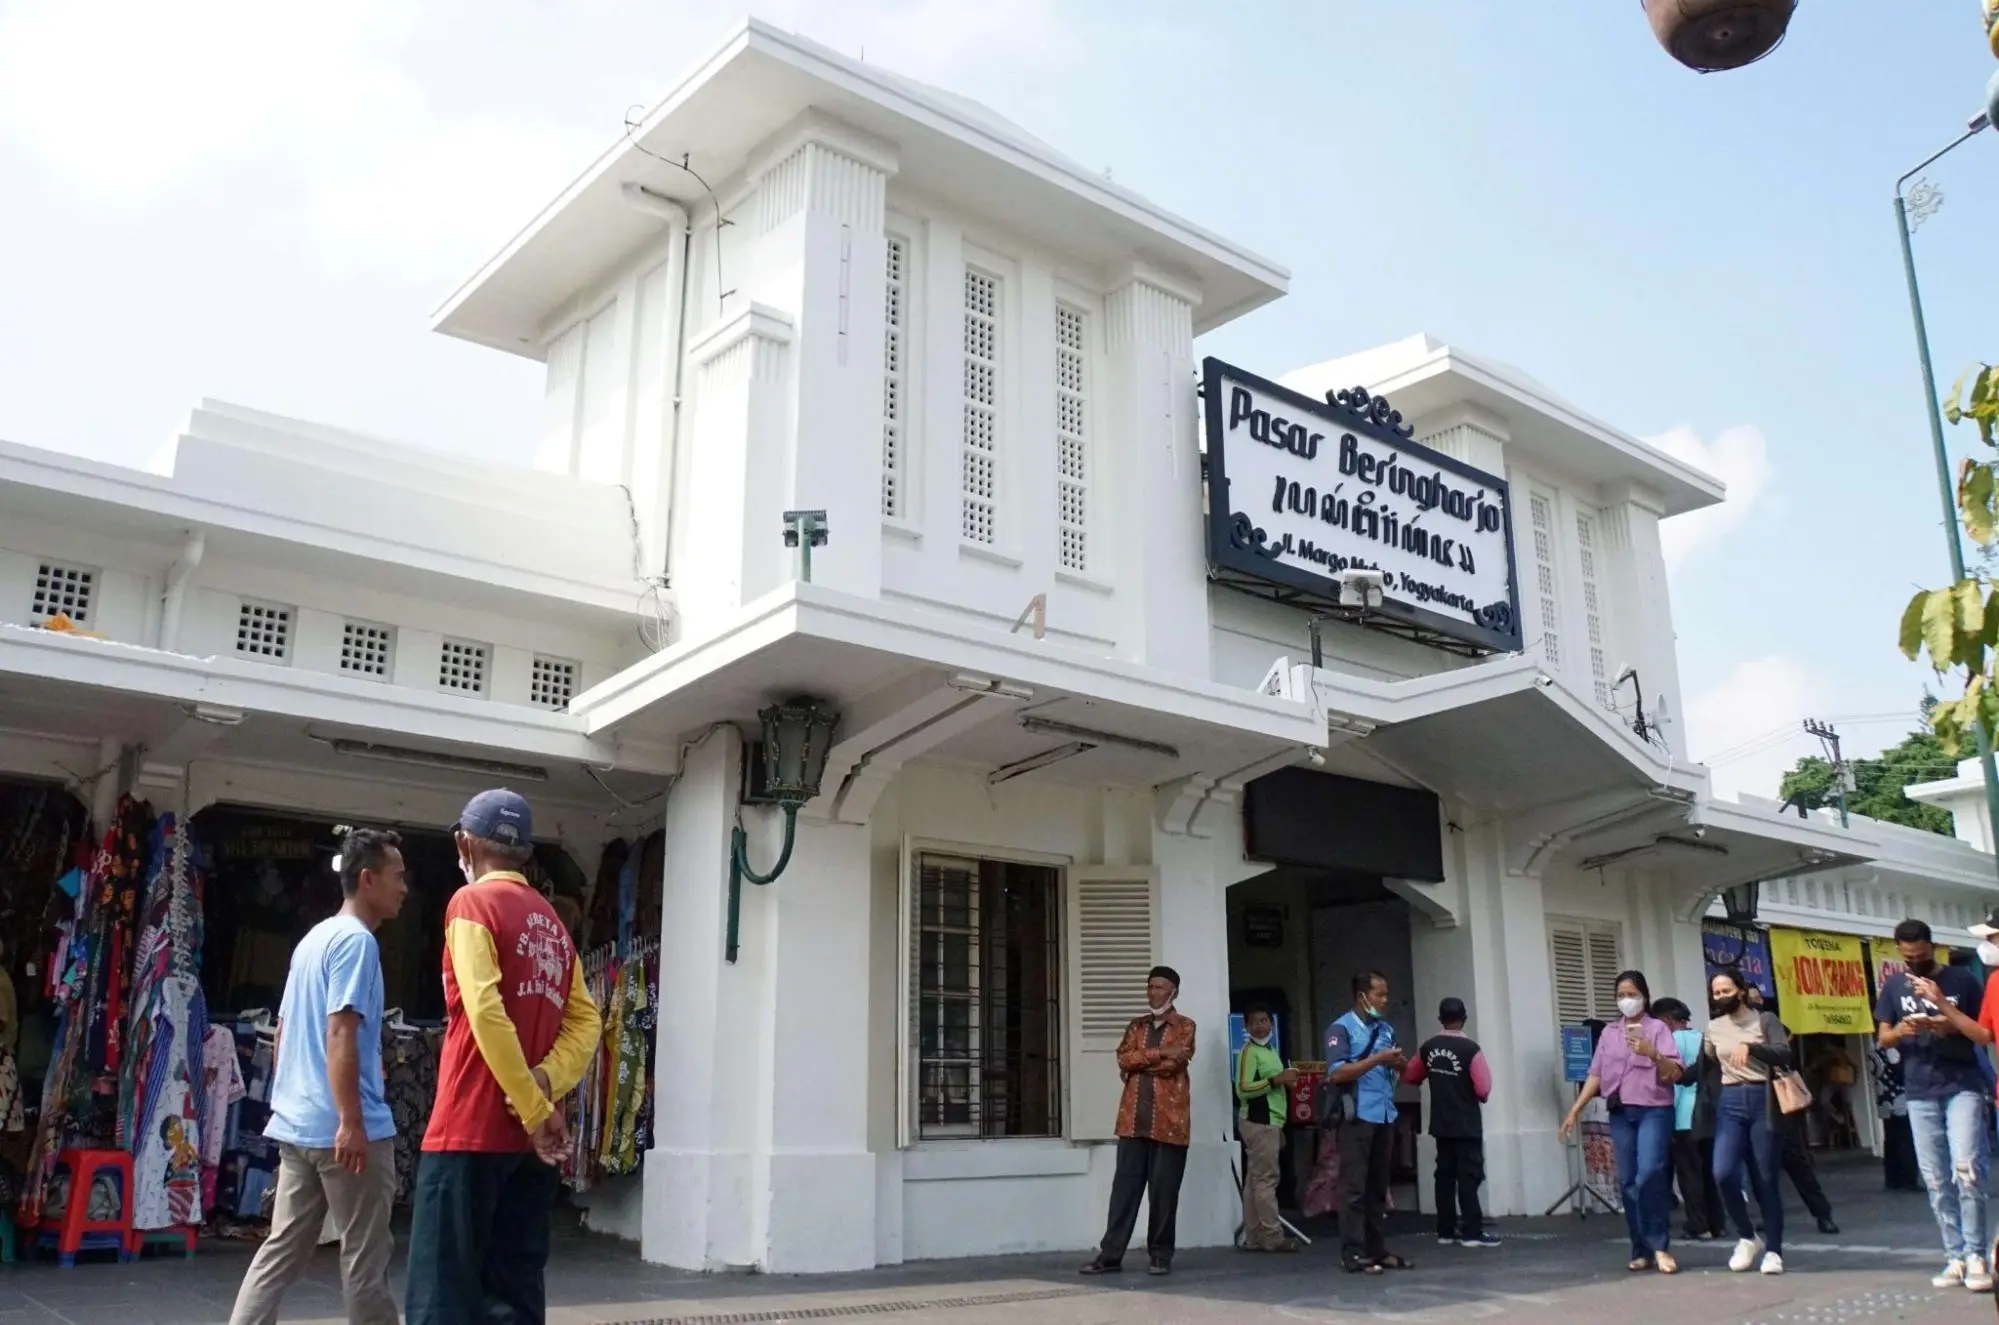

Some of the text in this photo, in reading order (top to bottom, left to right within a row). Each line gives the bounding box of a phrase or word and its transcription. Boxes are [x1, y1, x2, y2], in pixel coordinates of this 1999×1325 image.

[1229, 386, 1501, 533] Pasar Beringharjo
[1298, 539, 1348, 573] Margo
[1400, 571, 1475, 613] Yogyakarta
